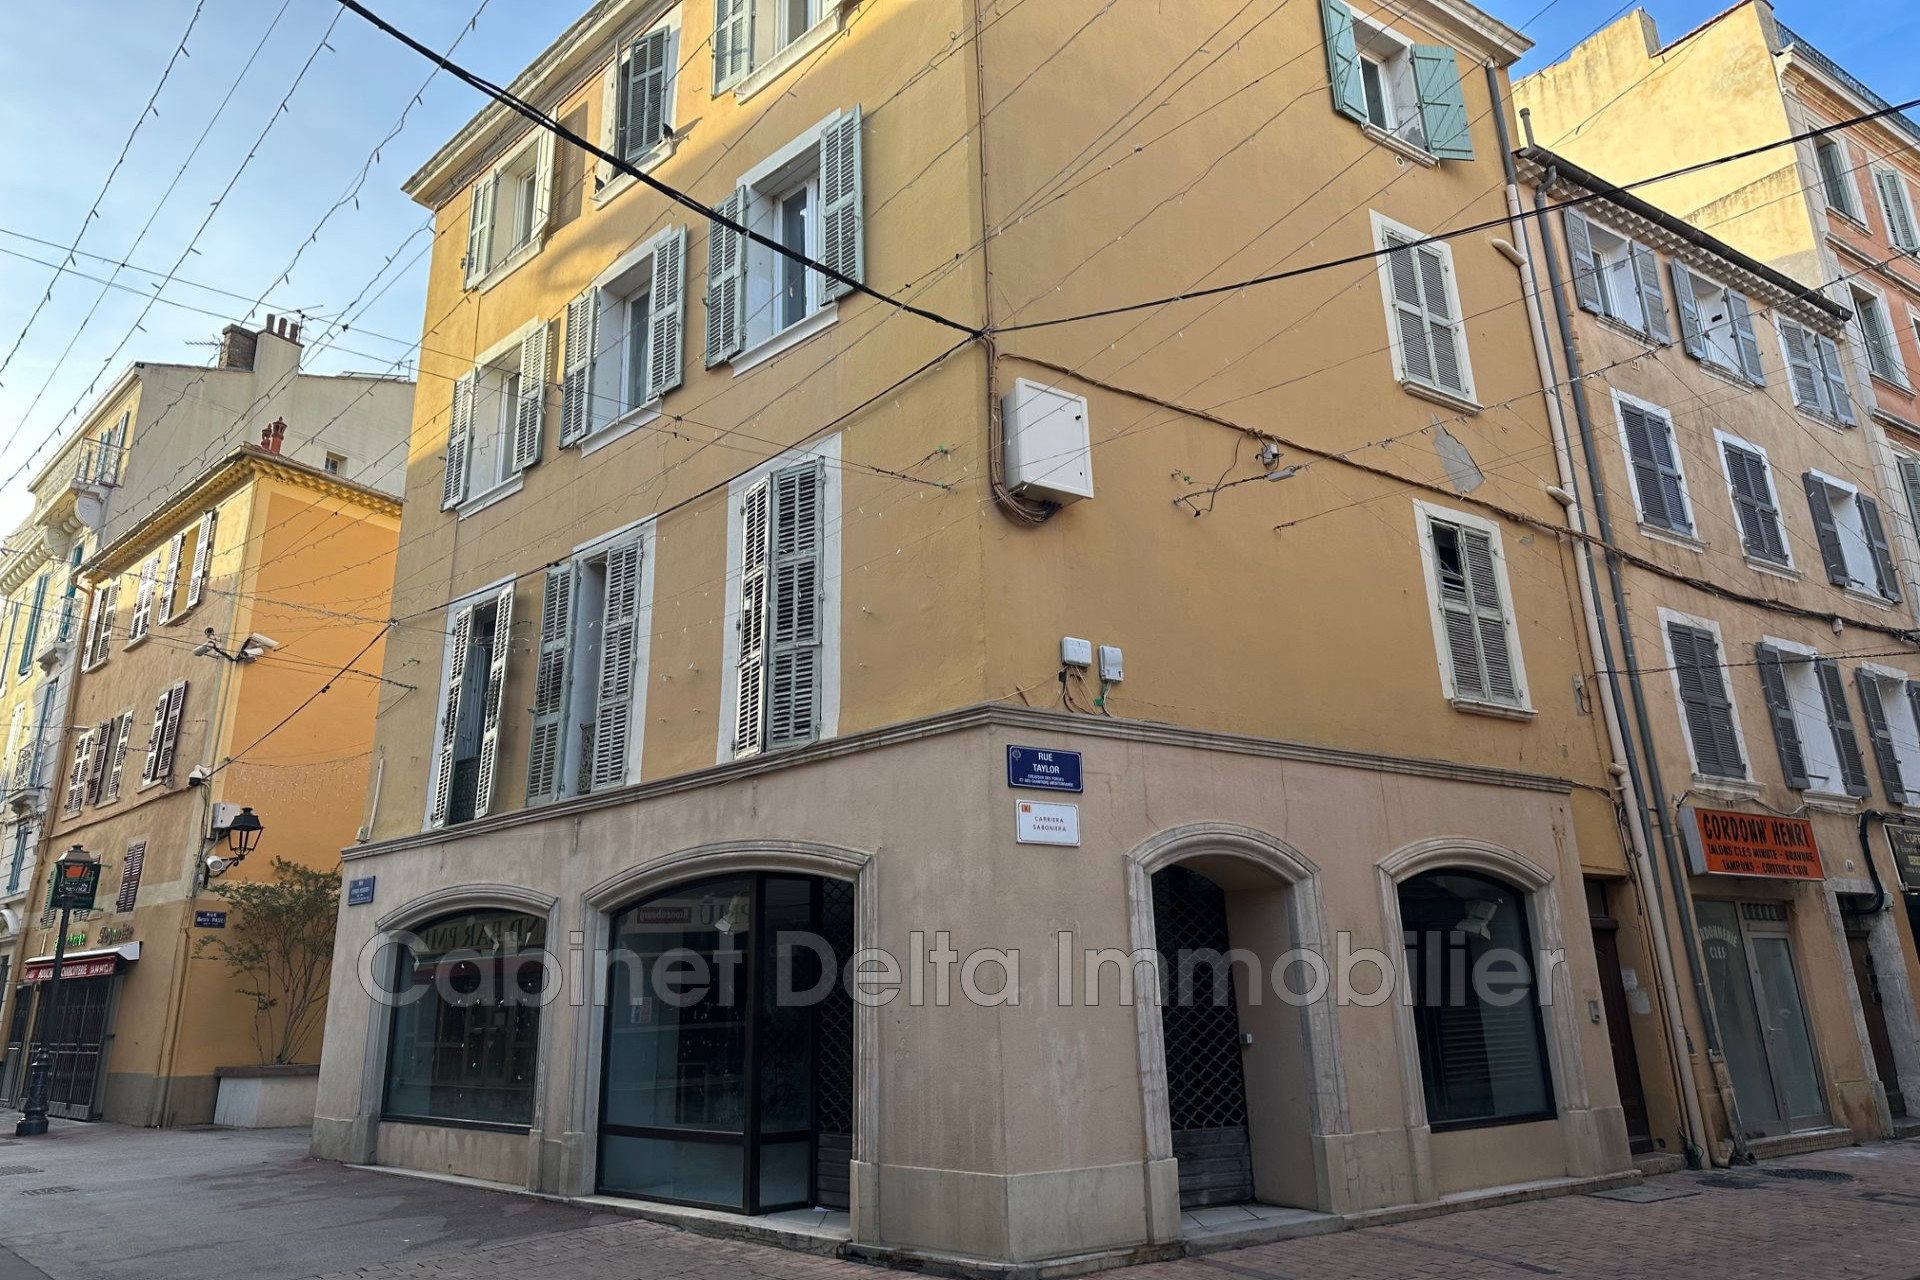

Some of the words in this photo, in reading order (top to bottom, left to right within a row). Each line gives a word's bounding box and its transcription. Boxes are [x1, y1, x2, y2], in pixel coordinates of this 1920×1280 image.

[1038, 752, 1053, 761] RUE
[1032, 763, 1060, 774] TAYLOR
[1771, 820, 1810, 848] HENRI
[1752, 847, 1778, 860] MINUTE
[1785, 850, 1815, 863] GRAVURE
[1722, 860, 1755, 872] TAMPONS
[1761, 862, 1792, 875] COUTURE
[1793, 864, 1809, 876] CUIR
